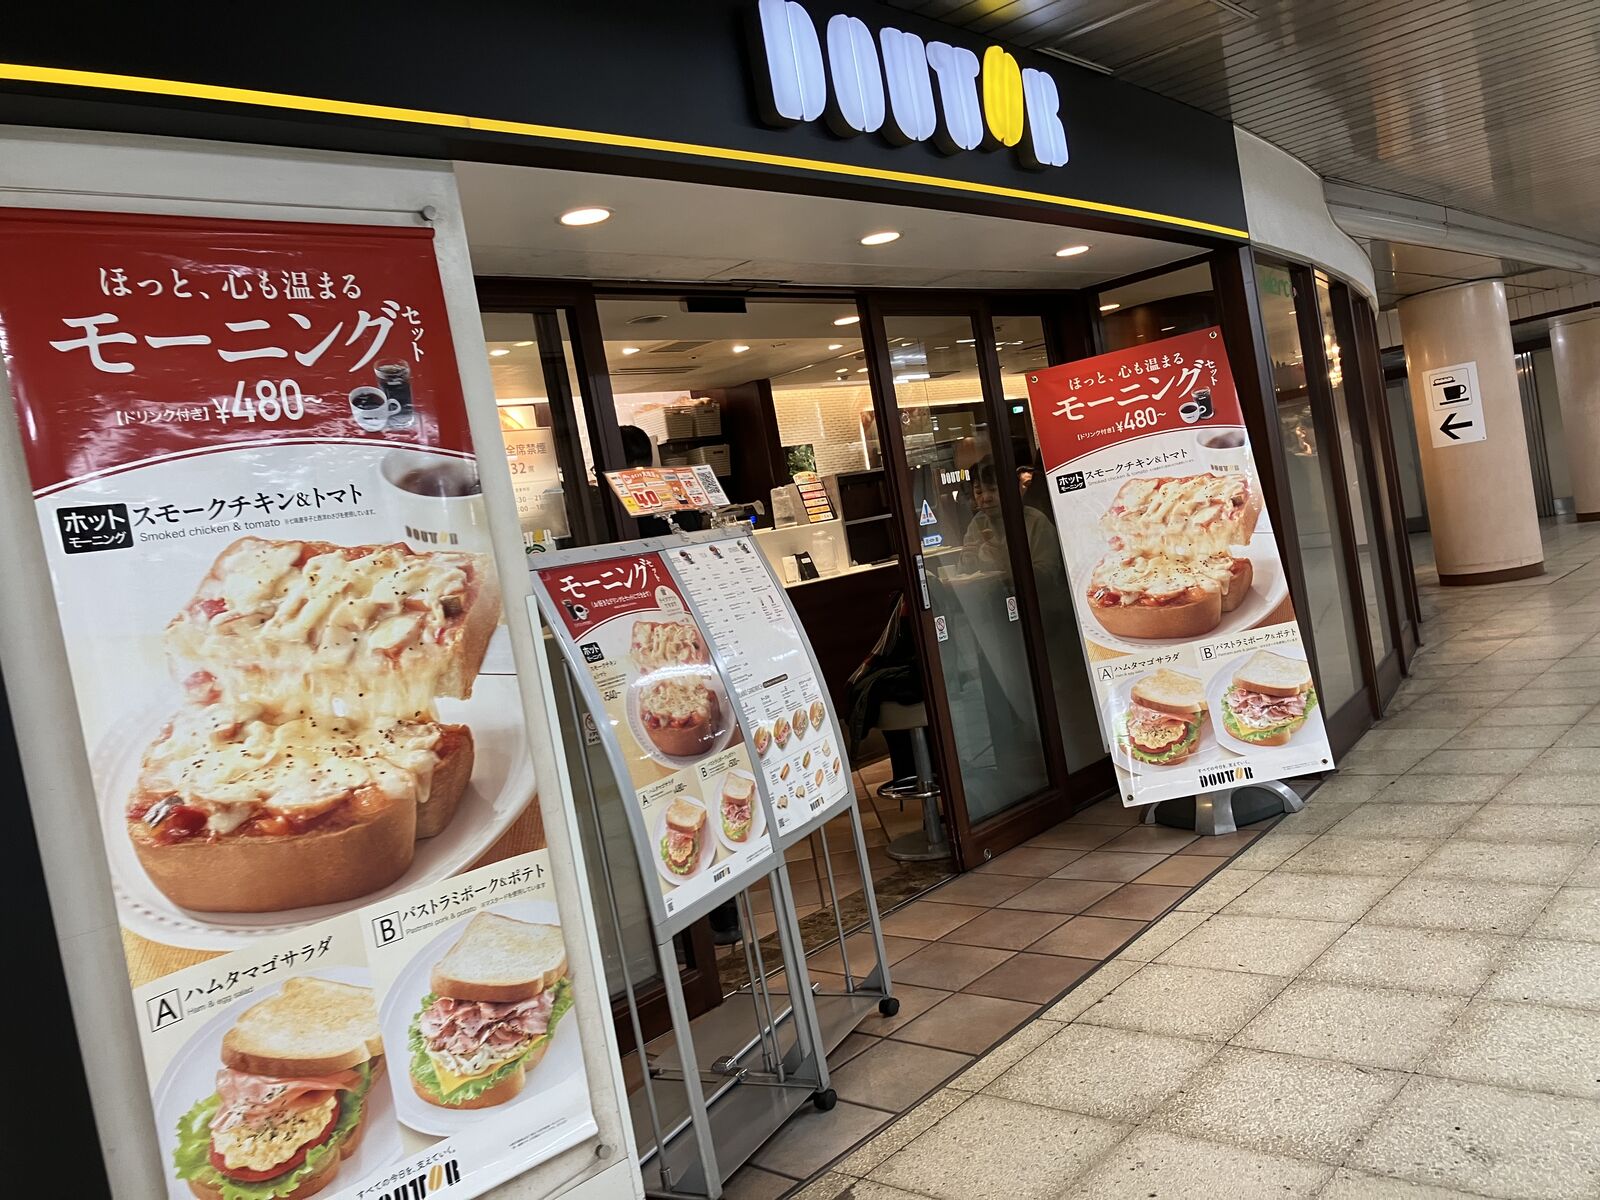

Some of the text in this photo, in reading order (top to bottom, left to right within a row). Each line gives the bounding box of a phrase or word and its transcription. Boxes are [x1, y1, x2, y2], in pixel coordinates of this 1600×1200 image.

[758, 0, 1069, 167] DOUTOR
[100, 267, 362, 299] ほっと、心も温まる
[49, 300, 401, 373] モーニング
[401, 305, 425, 362] セット
[1069, 352, 1184, 391] ほっと、心も温まる
[1204, 359, 1218, 386] セット
[1052, 359, 1204, 421] モーニング
[1085, 449, 1188, 481] スモークチキン&トマト
[1058, 474, 1083, 487] ホット
[63, 506, 126, 534] ホット
[133, 484, 362, 527] スモークチキン&トマト
[68, 532, 126, 549] モーニング
[140, 529, 186, 542] Smoked
[188, 523, 230, 537] chicken
[233, 521, 241, 531] &
[244, 518, 280, 530] tomato
[559, 558, 646, 599] モーニング
[1114, 652, 1180, 673] ハムタマゴサラダ
[1204, 647, 1213, 659] B
[1101, 669, 1112, 681] A
[1199, 766, 1254, 789] DOUTOR
[402, 864, 545, 922] パストラミポーク&ポテト
[380, 918, 396, 943] B
[184, 935, 333, 1002] ハムタマゴサラダ
[155, 999, 178, 1028] A
